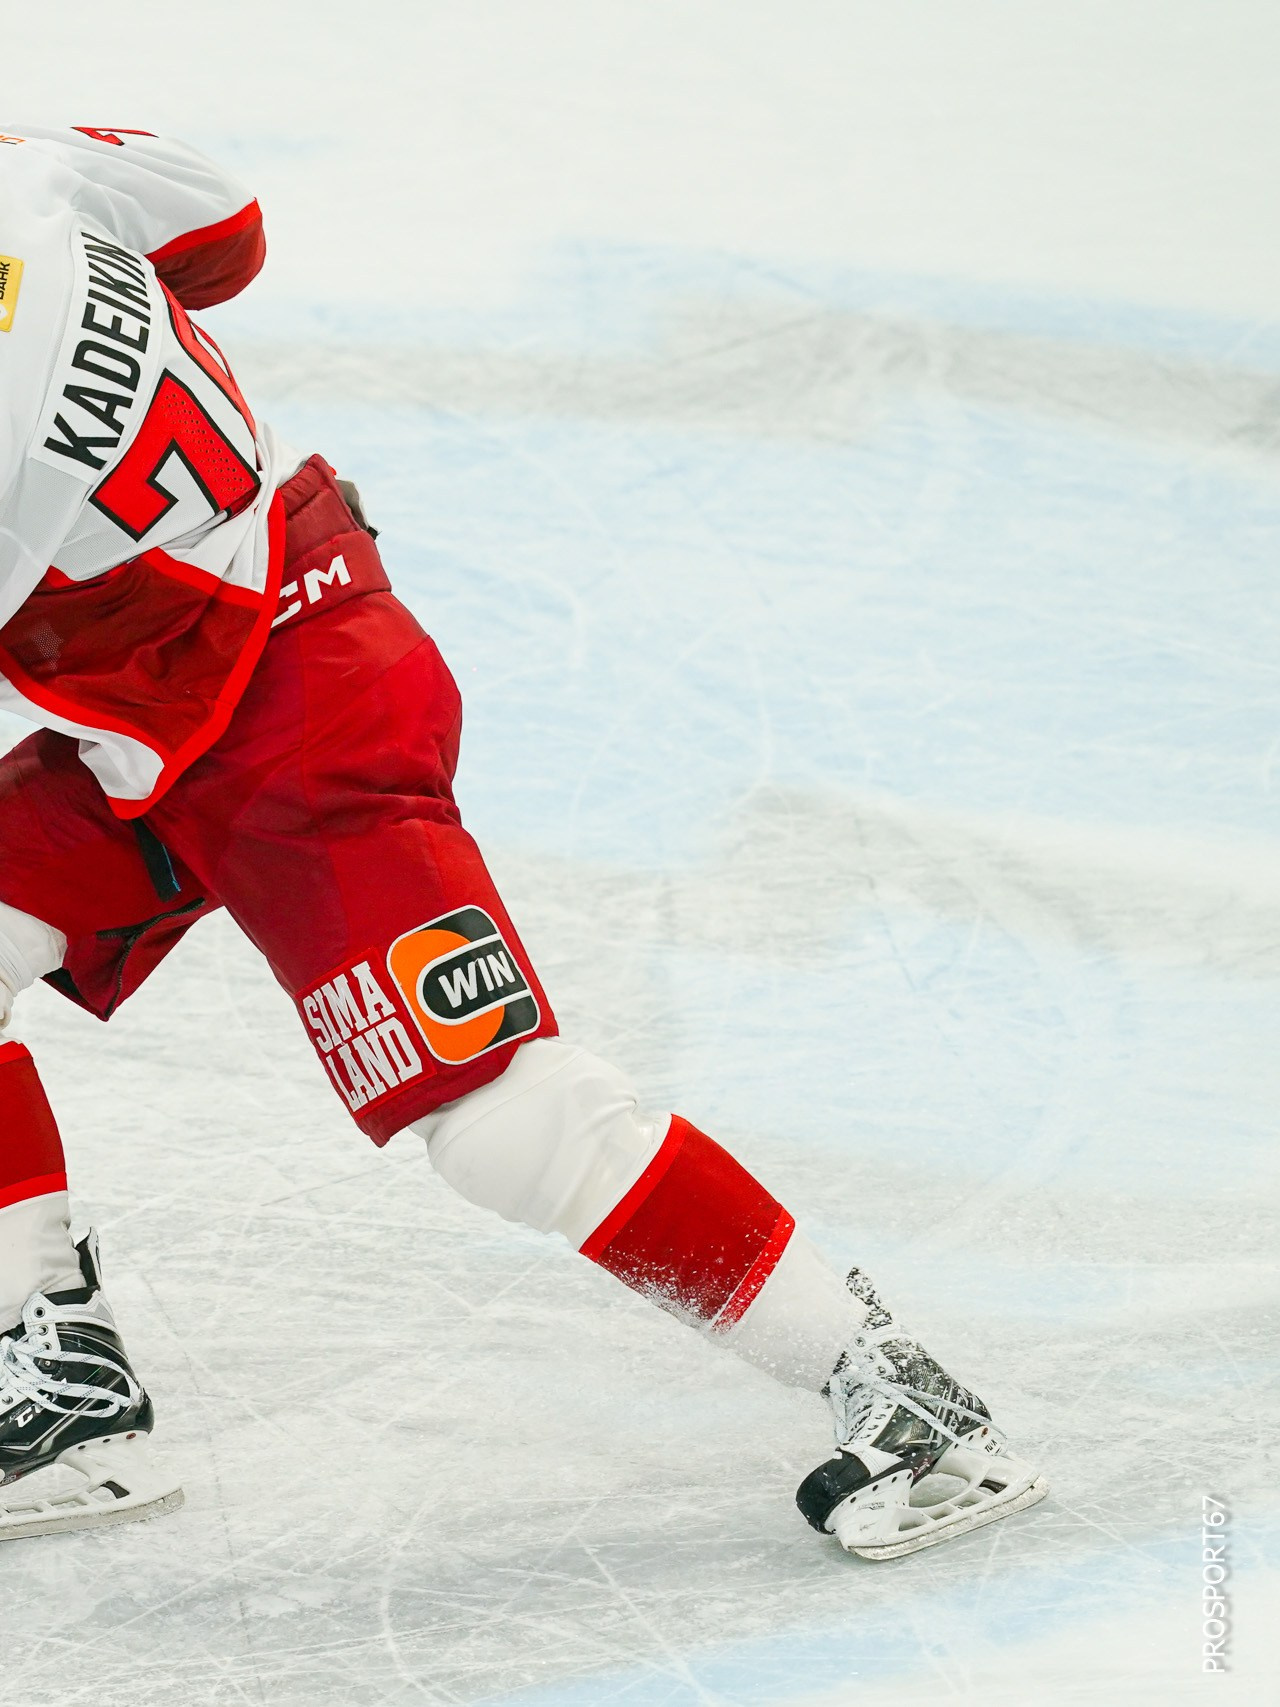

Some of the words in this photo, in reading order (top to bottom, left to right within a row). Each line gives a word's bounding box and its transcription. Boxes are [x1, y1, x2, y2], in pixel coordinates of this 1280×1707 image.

[43, 231, 152, 471] KADEIKIN
[302, 960, 397, 1054] SIMA
[438, 950, 516, 1009] WIN
[326, 1016, 423, 1113] LAND
